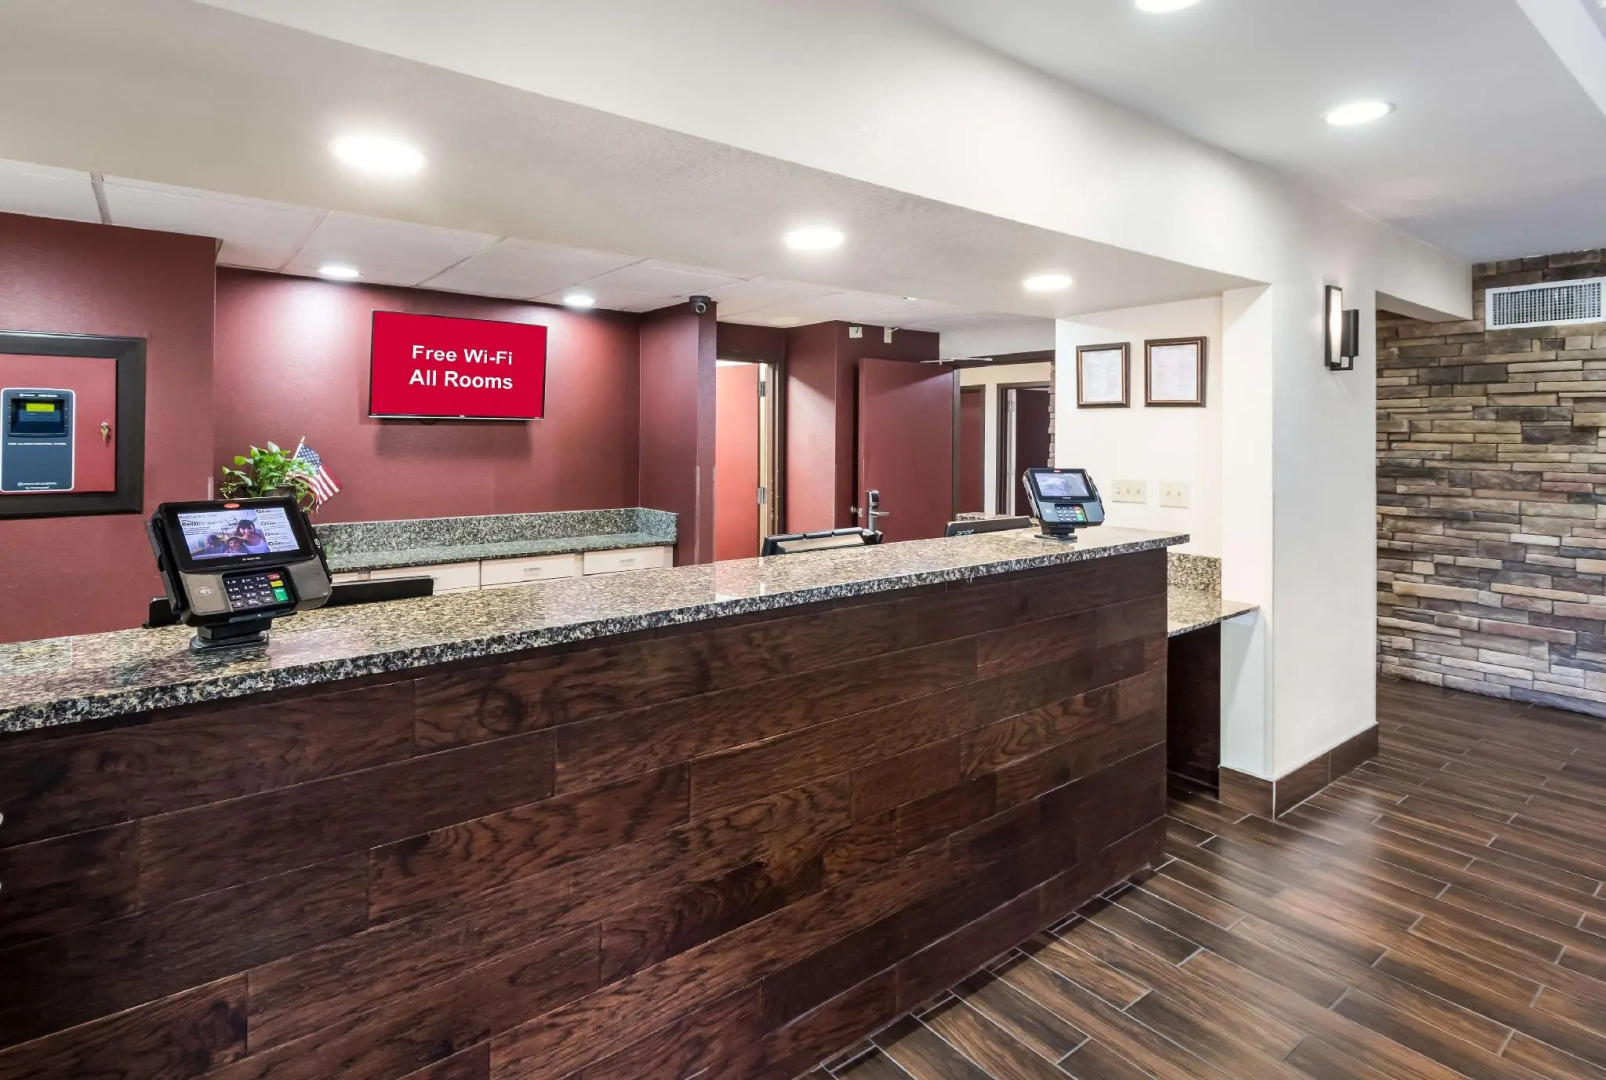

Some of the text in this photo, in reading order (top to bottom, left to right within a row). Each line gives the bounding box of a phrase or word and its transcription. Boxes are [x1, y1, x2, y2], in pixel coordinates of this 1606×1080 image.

[412, 345, 513, 365] Free Wi-Fi
[409, 369, 513, 390] All Rooms
